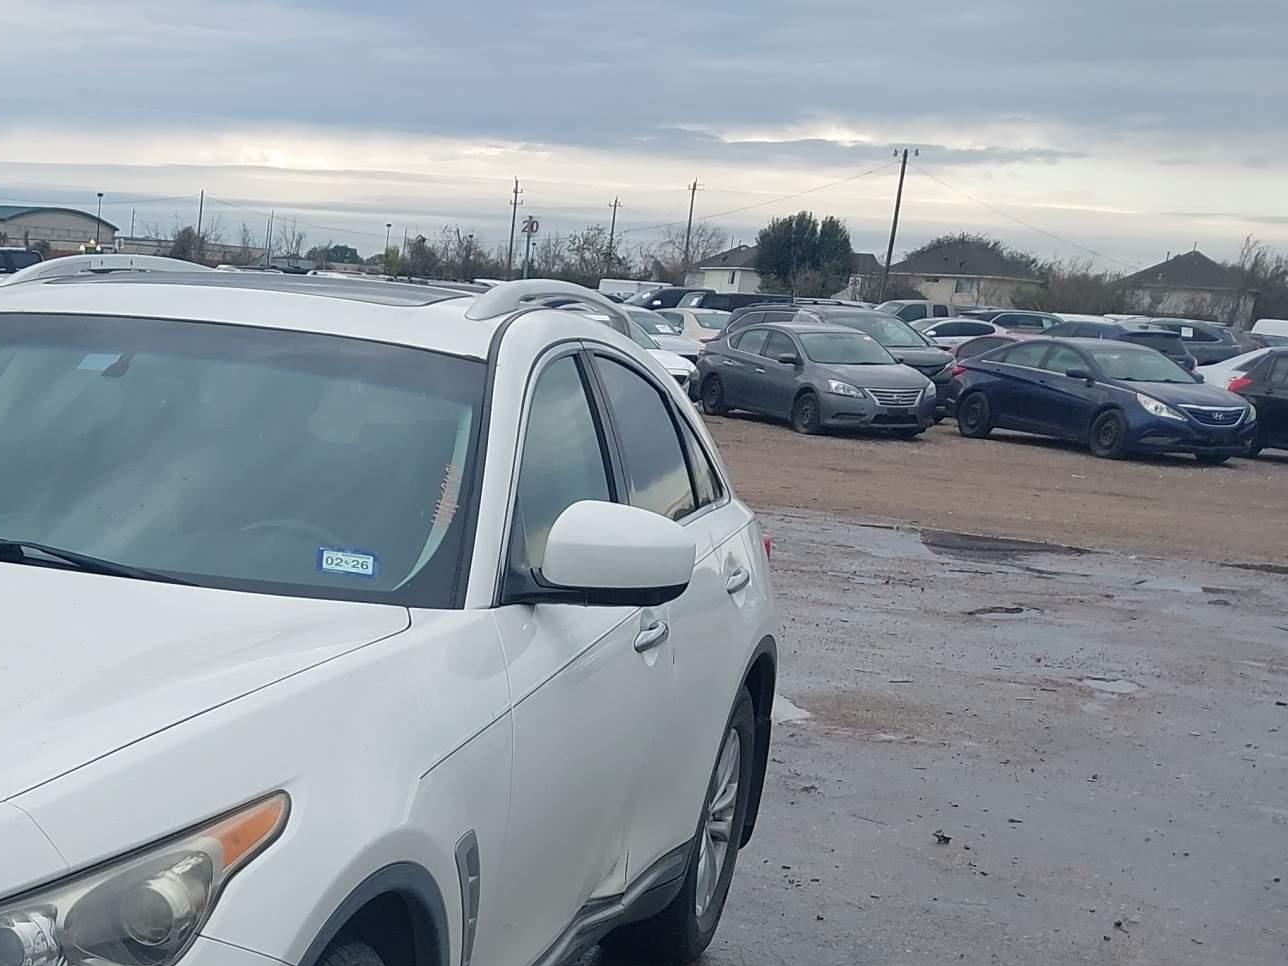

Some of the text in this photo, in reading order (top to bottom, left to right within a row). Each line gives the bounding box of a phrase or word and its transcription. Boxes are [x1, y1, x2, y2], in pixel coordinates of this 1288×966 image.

[521, 220, 539, 233] 20
[326, 556, 369, 569] 02 26
